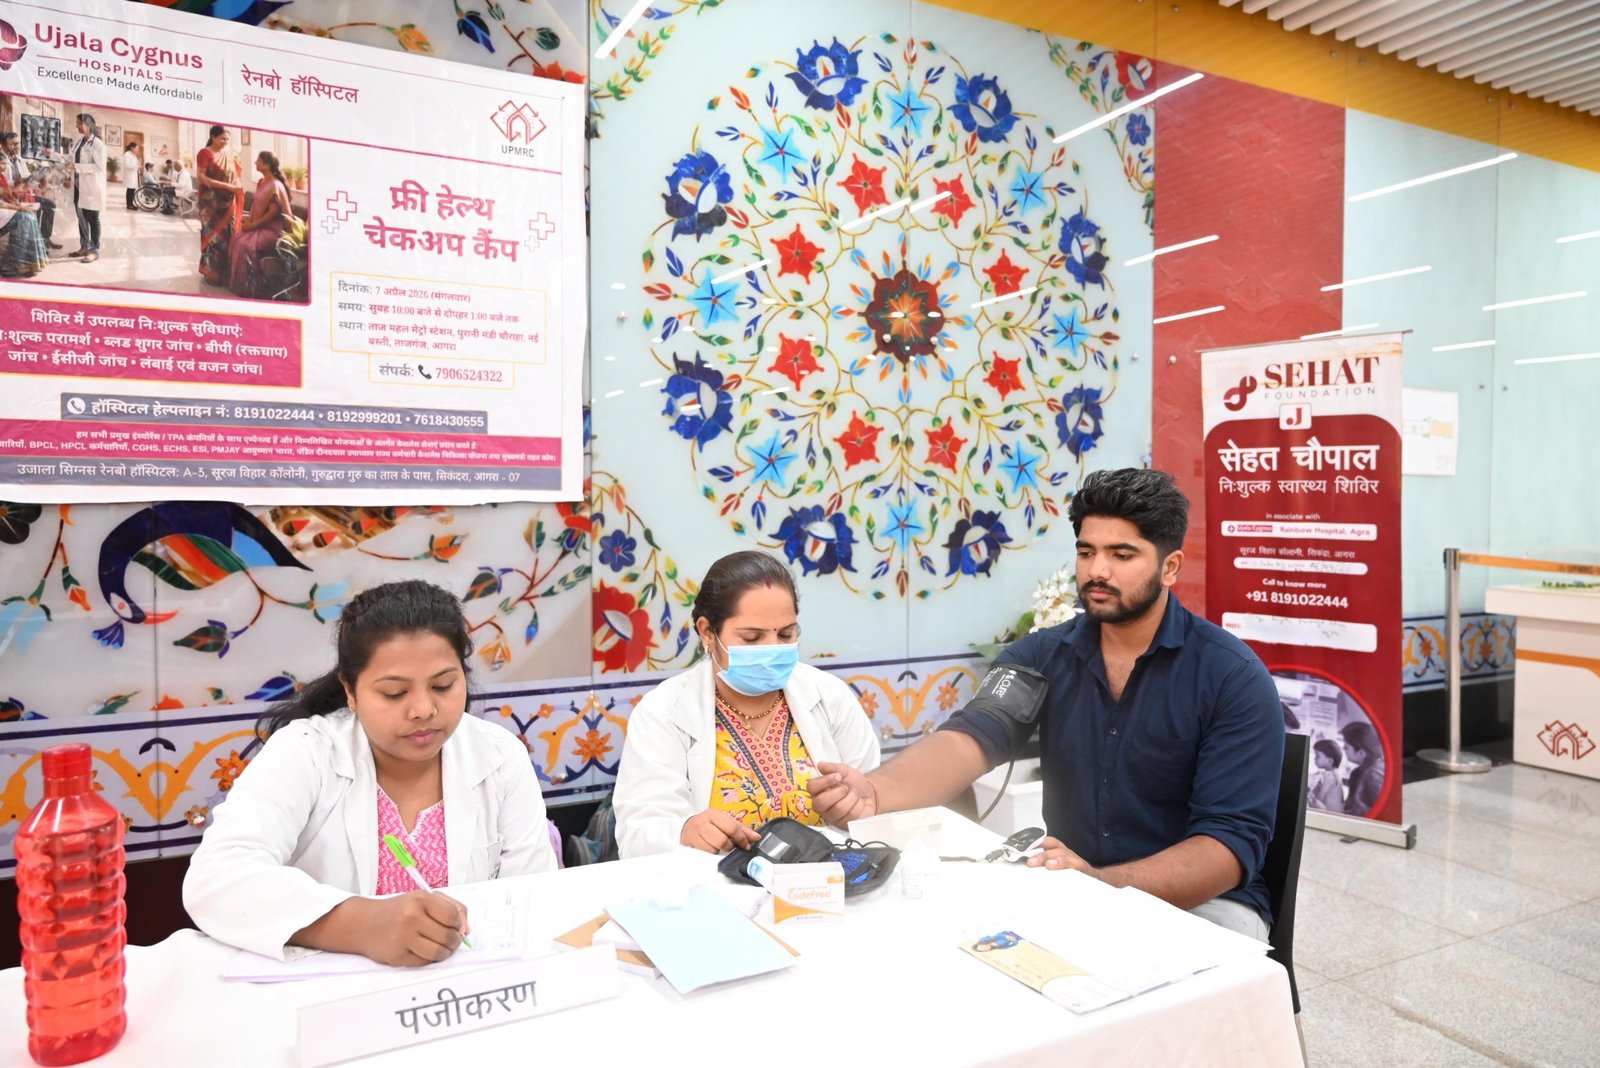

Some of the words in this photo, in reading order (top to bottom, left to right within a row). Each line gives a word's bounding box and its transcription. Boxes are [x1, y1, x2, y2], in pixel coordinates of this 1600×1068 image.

[34, 22, 103, 53] Ujala
[111, 37, 204, 70] Cygnus
[78, 58, 164, 81] HOSPITALS
[37, 66, 103, 84] Excellence
[107, 76, 140, 92] Made
[143, 82, 203, 102] Affordable
[241, 64, 281, 91] रेनबो
[291, 76, 358, 103] हॉस्पिटल
[243, 93, 276, 109] आगरा
[501, 144, 535, 158] UPMRC
[390, 180, 428, 214] फ्री
[437, 185, 495, 221] हेल्थ
[363, 216, 465, 257] चेकअप
[473, 229, 519, 262] कैंप
[338, 280, 372, 294] दिनांक:
[375, 286, 381, 295] 7
[408, 289, 429, 299] 2026
[430, 292, 471, 304] (मंगलवार)
[31, 308, 70, 325] शिविर
[74, 310, 85, 326] में
[88, 317, 135, 330] उपलब्ध
[338, 302, 366, 312] समय:
[369, 303, 389, 314] सुबह
[392, 305, 414, 315] 10:00
[417, 307, 431, 316] बजे
[434, 308, 442, 317] से
[444, 308, 468, 320] दोपहर
[505, 315, 519, 323] तक
[338, 321, 366, 331] स्थान:
[368, 323, 387, 331] ताज
[389, 324, 409, 334] महल
[458, 328, 479, 340] पुरानी
[46, 331, 91, 348] परामर्श
[104, 336, 131, 349] ब्लड
[135, 337, 163, 353] शुगर
[166, 338, 193, 352] जांच
[205, 341, 233, 356] बीपी
[236, 345, 288, 360] (रक्तचाप)
[432, 342, 456, 351] आगरा
[8, 349, 38, 363] जांच
[52, 350, 95, 367] ईसीजी
[99, 354, 127, 368] जांच
[140, 356, 174, 372] लंबाई
[177, 359, 195, 373] एवं
[199, 361, 229, 374] वजन
[1264, 356, 1380, 389] SEHAT
[379, 363, 414, 378] संपर्क:
[435, 366, 503, 383] 7906524322
[1264, 386, 1377, 400] FOUNDATION
[91, 398, 149, 416] हॉस्पिटल
[152, 401, 211, 419] हेल्पलाइन
[215, 404, 230, 418] नं:
[234, 405, 315, 421] 8191022444
[327, 410, 402, 426] 8192999201
[414, 413, 484, 428] 7618430555
[30, 441, 58, 451] BPCL,
[61, 442, 87, 450] HPCL
[132, 444, 161, 452] CGHS,
[193, 445, 209, 453] ESI,
[211, 446, 240, 454] PMJAY
[167, 433, 185, 441] TPA
[1218, 439, 1280, 472] सेहत
[1290, 436, 1380, 471] चौपाल
[17, 463, 56, 475] उजाला
[59, 461, 96, 475] सिग्नस
[100, 462, 127, 476] रेनबो
[130, 463, 179, 478] हॉस्पिटल:
[183, 467, 208, 478] A-3,
[211, 467, 236, 480] सूरज
[240, 465, 266, 479] विहार
[270, 466, 308, 480] कॉलोनी,
[312, 469, 345, 482] गुरुद्वारा
[347, 470, 362, 482] गुरु
[364, 470, 378, 480] का
[380, 471, 398, 481] ताल
[401, 469, 410, 481] के
[413, 471, 433, 482] पास,
[436, 470, 472, 483] सिकंदरा,
[474, 473, 499, 482] आगरा
[509, 472, 520, 482] 07
[1278, 480, 1327, 494] स्वास्थ्य
[1334, 476, 1380, 494] शिविर
[1280, 526, 1312, 534] Rainbow
[1314, 527, 1347, 536] Hospital,
[1350, 528, 1370, 537] Agra
[1262, 578, 1276, 586] Call
[1284, 579, 1305, 587] know
[1307, 581, 1327, 589] more
[1246, 590, 1268, 602] +91
[1270, 592, 1349, 608] 8191022444
[395, 980, 537, 1034] पंजीकरण
